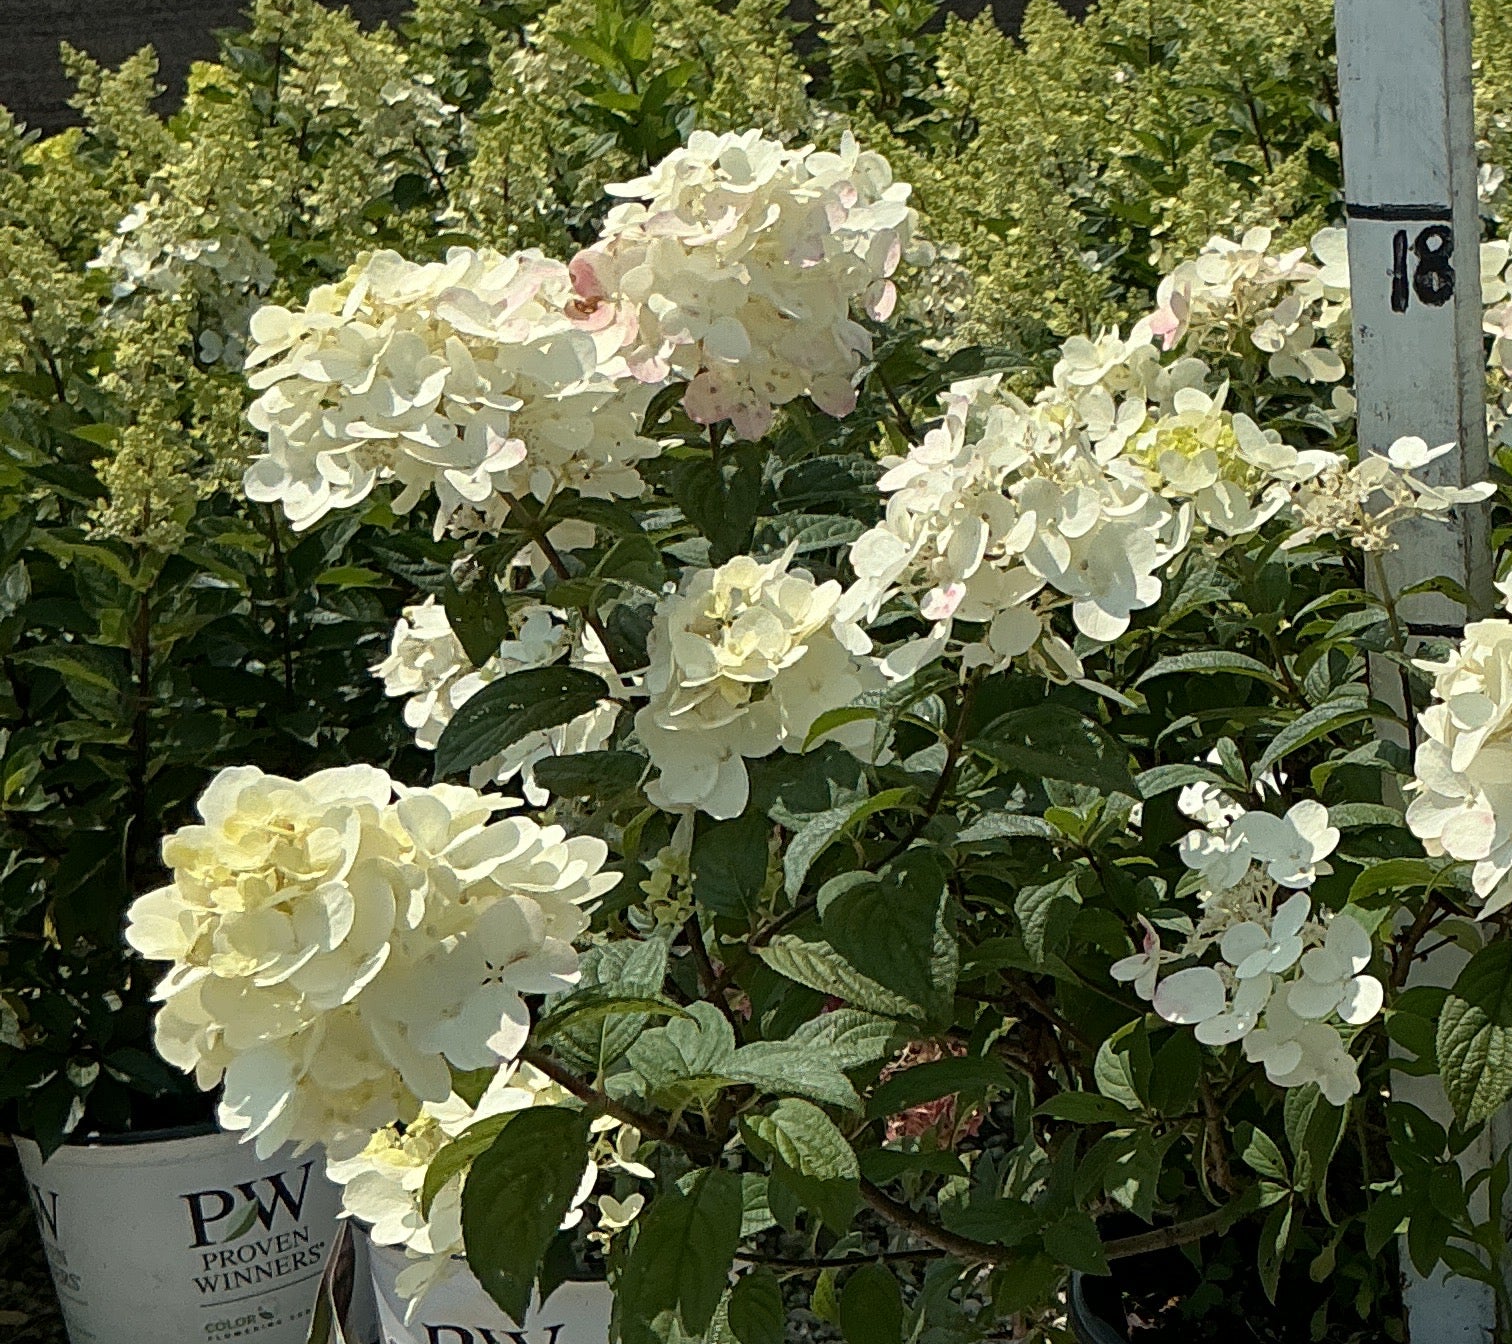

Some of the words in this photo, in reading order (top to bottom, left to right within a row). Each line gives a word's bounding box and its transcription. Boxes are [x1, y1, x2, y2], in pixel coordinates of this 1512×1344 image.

[1391, 224, 1456, 313] 18
[179, 1160, 316, 1249] PW
[202, 1225, 310, 1272] PROVEN
[204, 1314, 257, 1334] COLOR
